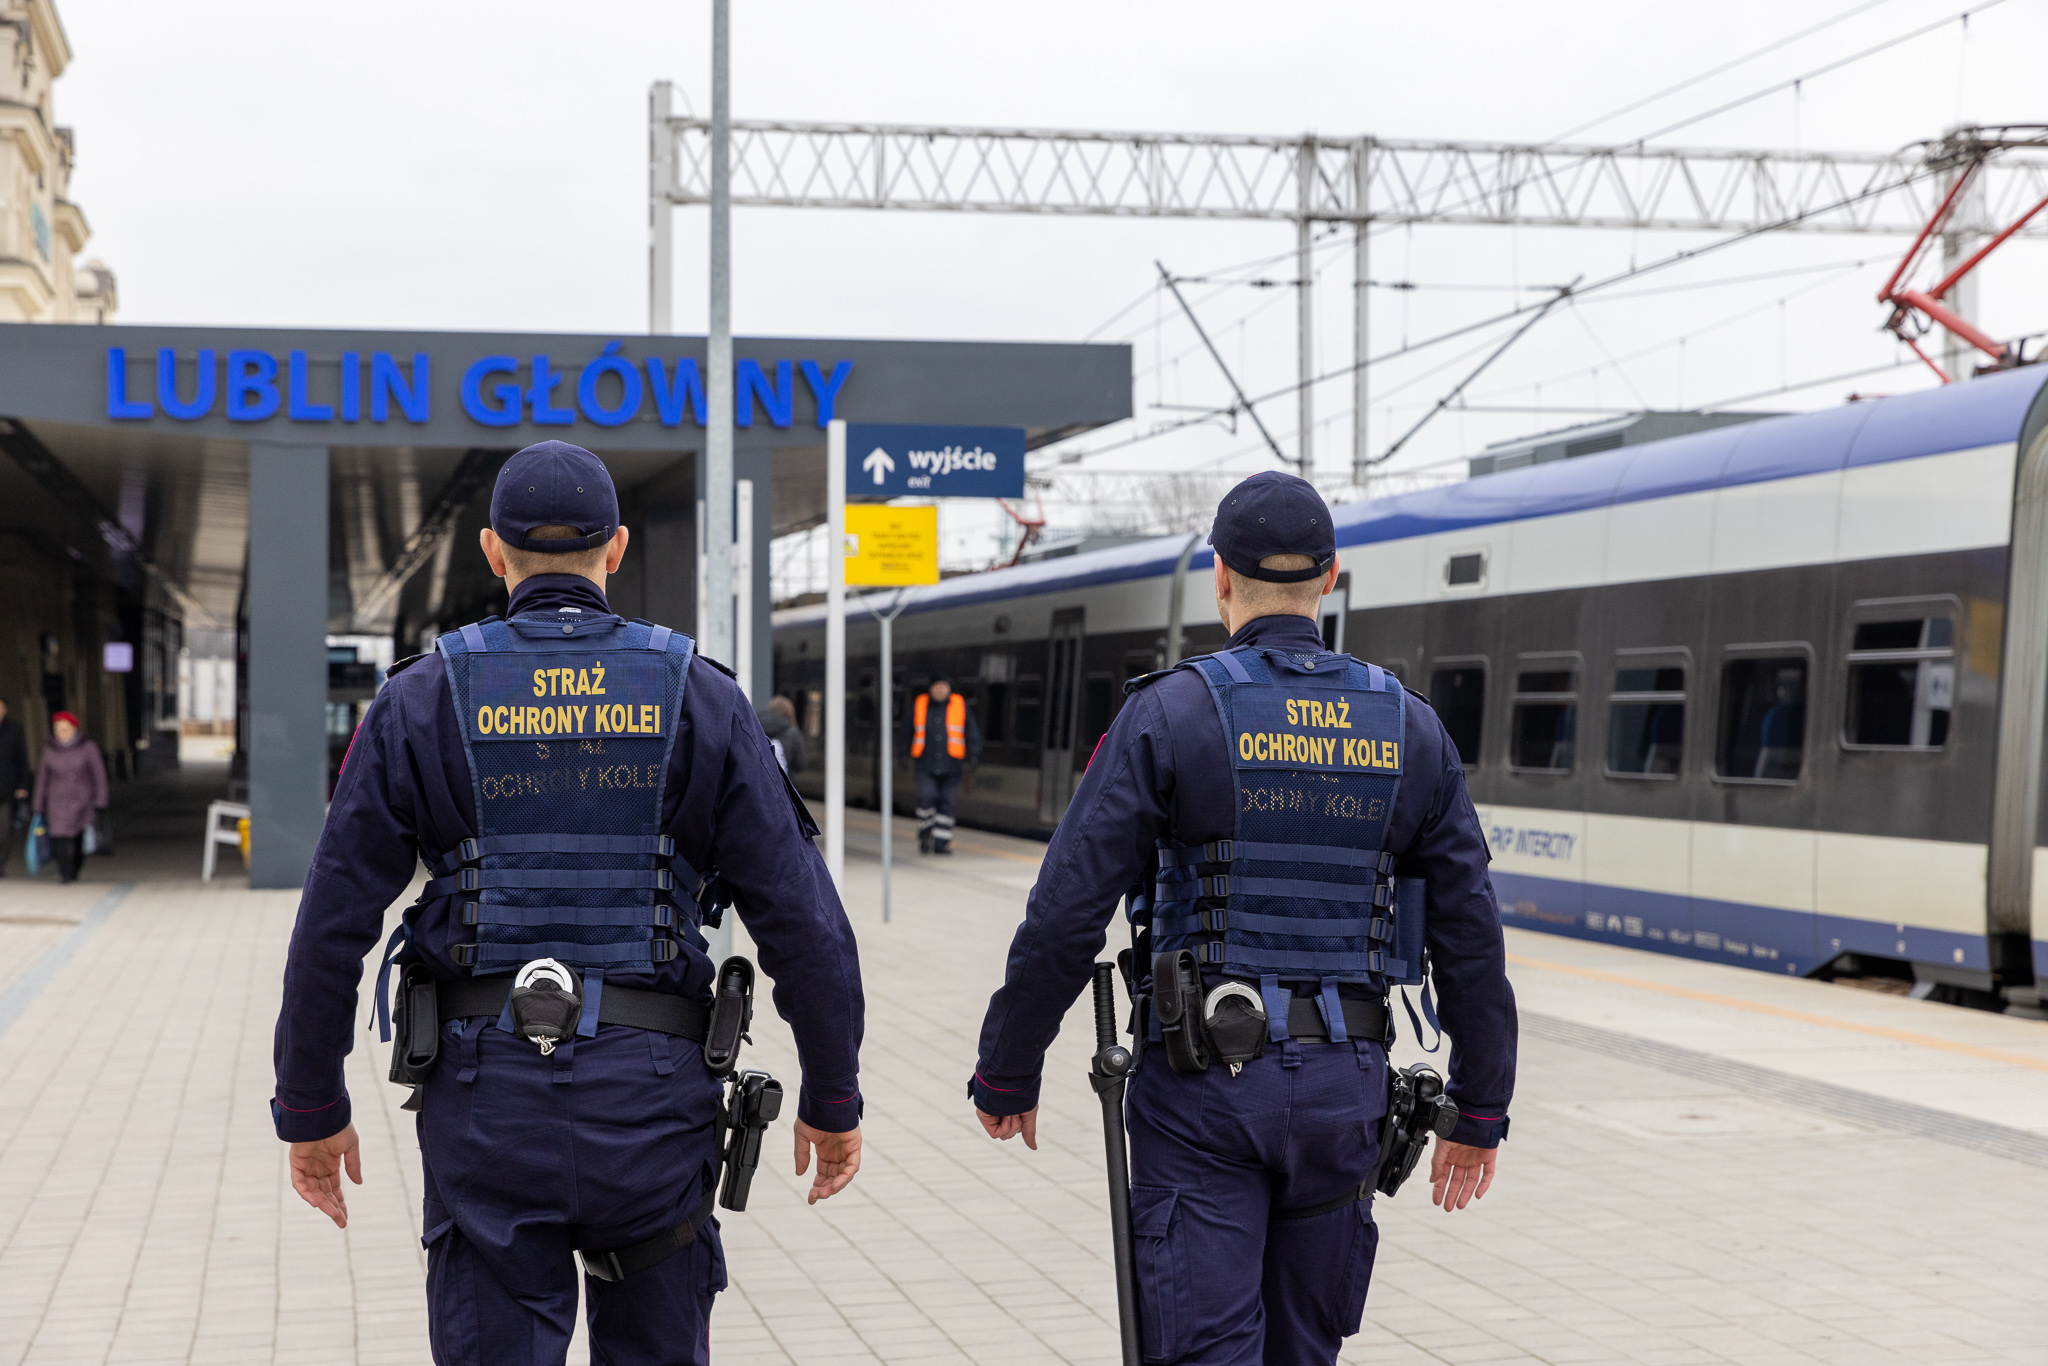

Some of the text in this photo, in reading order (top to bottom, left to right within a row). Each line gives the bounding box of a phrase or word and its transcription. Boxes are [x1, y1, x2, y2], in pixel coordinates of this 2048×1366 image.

[107, 340, 855, 428] LUBLIN GŁÓWNY
[908, 446, 997, 475] wyjście
[907, 475, 931, 488] exit
[533, 661, 606, 697] STRAŻ
[478, 704, 661, 735] OCHRONY KOLEI
[1286, 696, 1352, 728] STRAŻ
[1239, 733, 1399, 769] OCHRONY KOLEI
